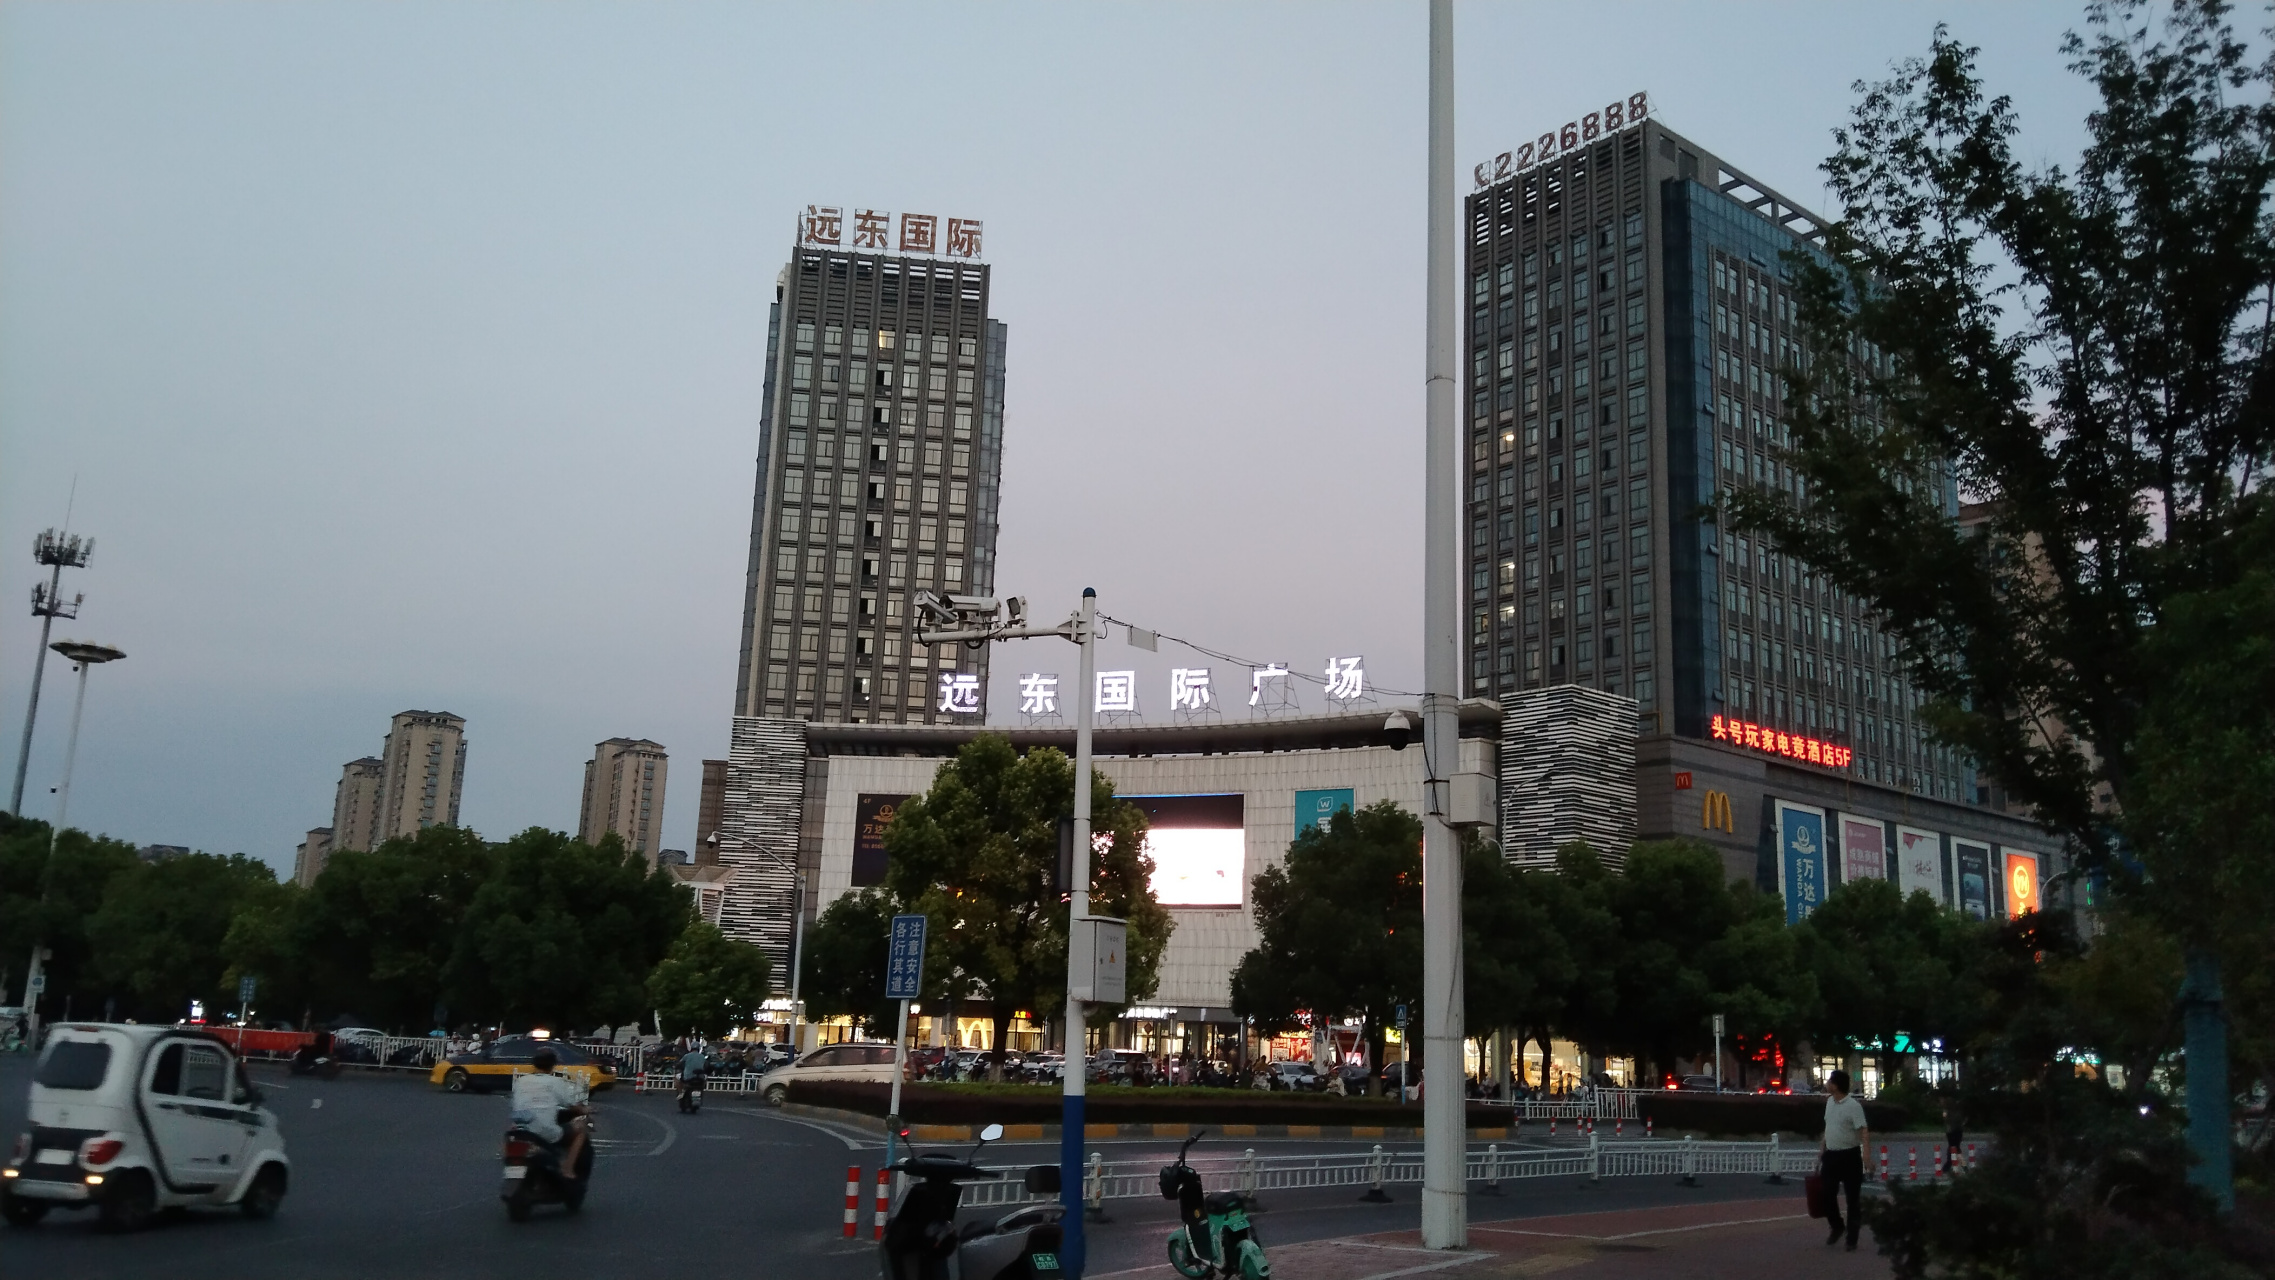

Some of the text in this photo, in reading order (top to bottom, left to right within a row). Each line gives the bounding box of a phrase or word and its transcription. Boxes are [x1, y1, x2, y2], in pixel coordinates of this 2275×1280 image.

[805, 204, 982, 258] 远东国际
[939, 656, 1365, 714] 远东国际广场
[1711, 715, 1852, 768] 头号玩家电竞酒店5F
[891, 921, 907, 992] 各行其道
[904, 921, 921, 992] 注意安全
